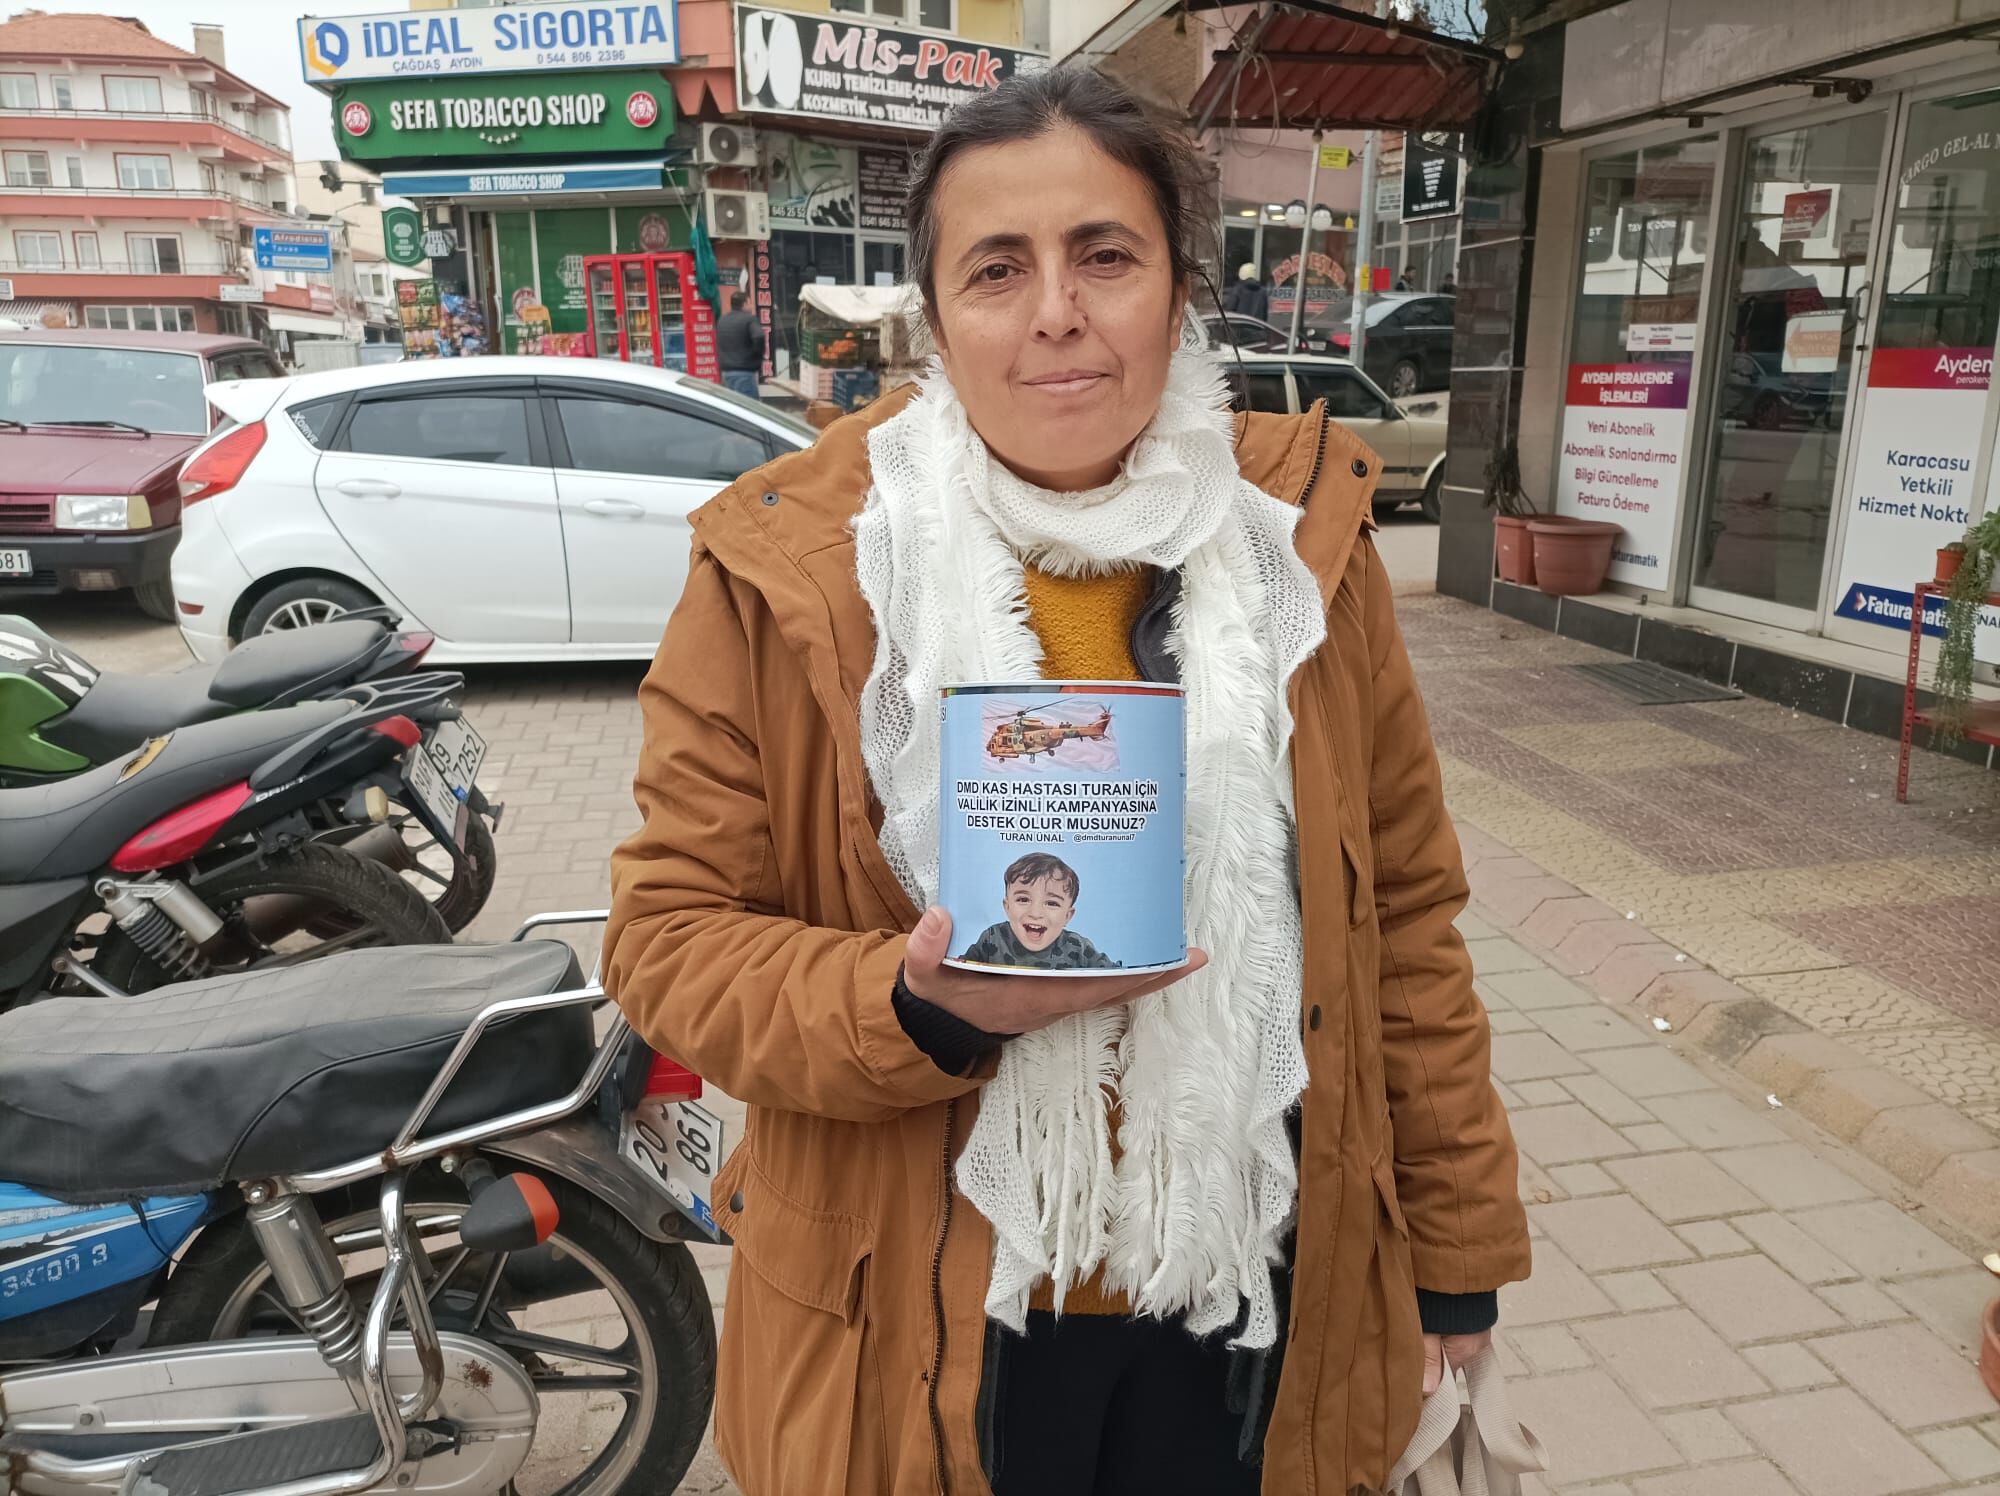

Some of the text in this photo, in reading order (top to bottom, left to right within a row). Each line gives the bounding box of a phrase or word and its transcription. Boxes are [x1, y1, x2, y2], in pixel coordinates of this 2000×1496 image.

[392, 56, 483, 72] ÇAĞDAŞ AYDIN
[537, 53, 543, 64] 0
[546, 52, 566, 63] 544
[812, 22, 1002, 90] Mis-Pak
[804, 68, 842, 89] KURU
[390, 93, 606, 130] SEFA TOBACCO SHOP
[802, 93, 868, 119] KOZMETİK
[868, 104, 885, 119] ve
[887, 102, 942, 125] TEMİZLİK
[1943, 132, 1991, 159] GEL-AL
[469, 173, 565, 191] SEFA TOBACCO SHOP
[1581, 371, 1674, 385] AYDEM PERAKENDE
[1599, 387, 1649, 404] İŞLEMLERİ
[1587, 420, 1655, 436] Yeni Abonelik
[1564, 443, 1677, 464] Abonelik Sonlandırma
[1887, 450, 1970, 471] Karacasu
[1575, 468, 1659, 488] Bilgi Güncelleme
[1900, 475, 1953, 496] Yetkili
[1577, 492, 1650, 513] Fatura Ödeme
[1858, 496, 1916, 518] Hizmet
[453, 734, 481, 784] 7252
[957, 779, 1158, 798] DMD KAS HASTASI TURAN İÇİN
[957, 796, 1157, 813] VALİLİK İZİNLİ KAMPANYASINA
[967, 815, 1145, 830] DESTEK OLUR MUSUNUZ?
[1000, 832, 1033, 842] TURAN
[1036, 832, 1065, 843] ÜNAL
[675, 1100, 712, 1175] 861
[632, 1119, 668, 1182] 20
